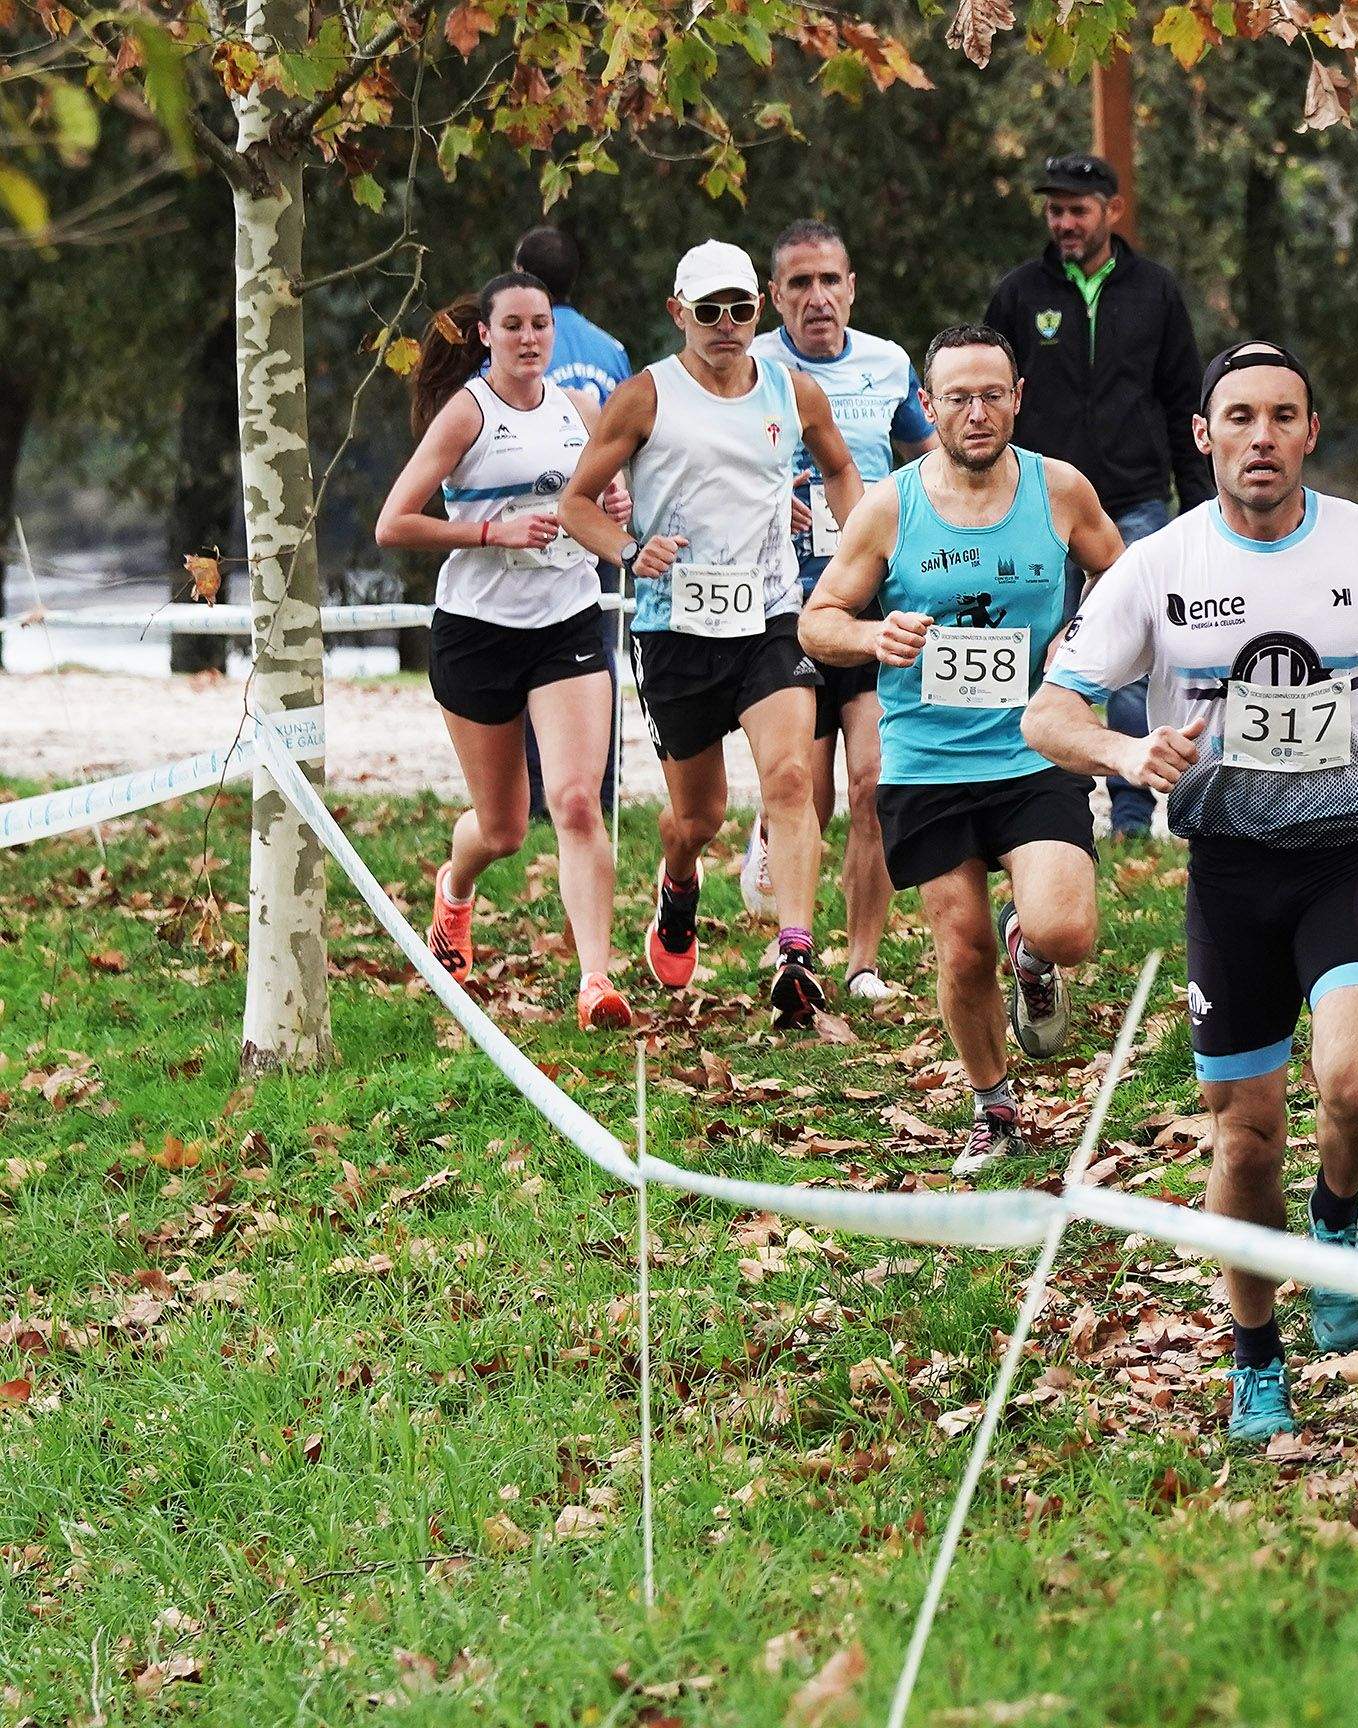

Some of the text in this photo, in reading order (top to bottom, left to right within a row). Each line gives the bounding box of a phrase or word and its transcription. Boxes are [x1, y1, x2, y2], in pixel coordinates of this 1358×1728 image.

[684, 582, 753, 615] 350
[1189, 596, 1246, 620] ence
[935, 646, 1016, 683] 358
[1241, 700, 1337, 744] 317
